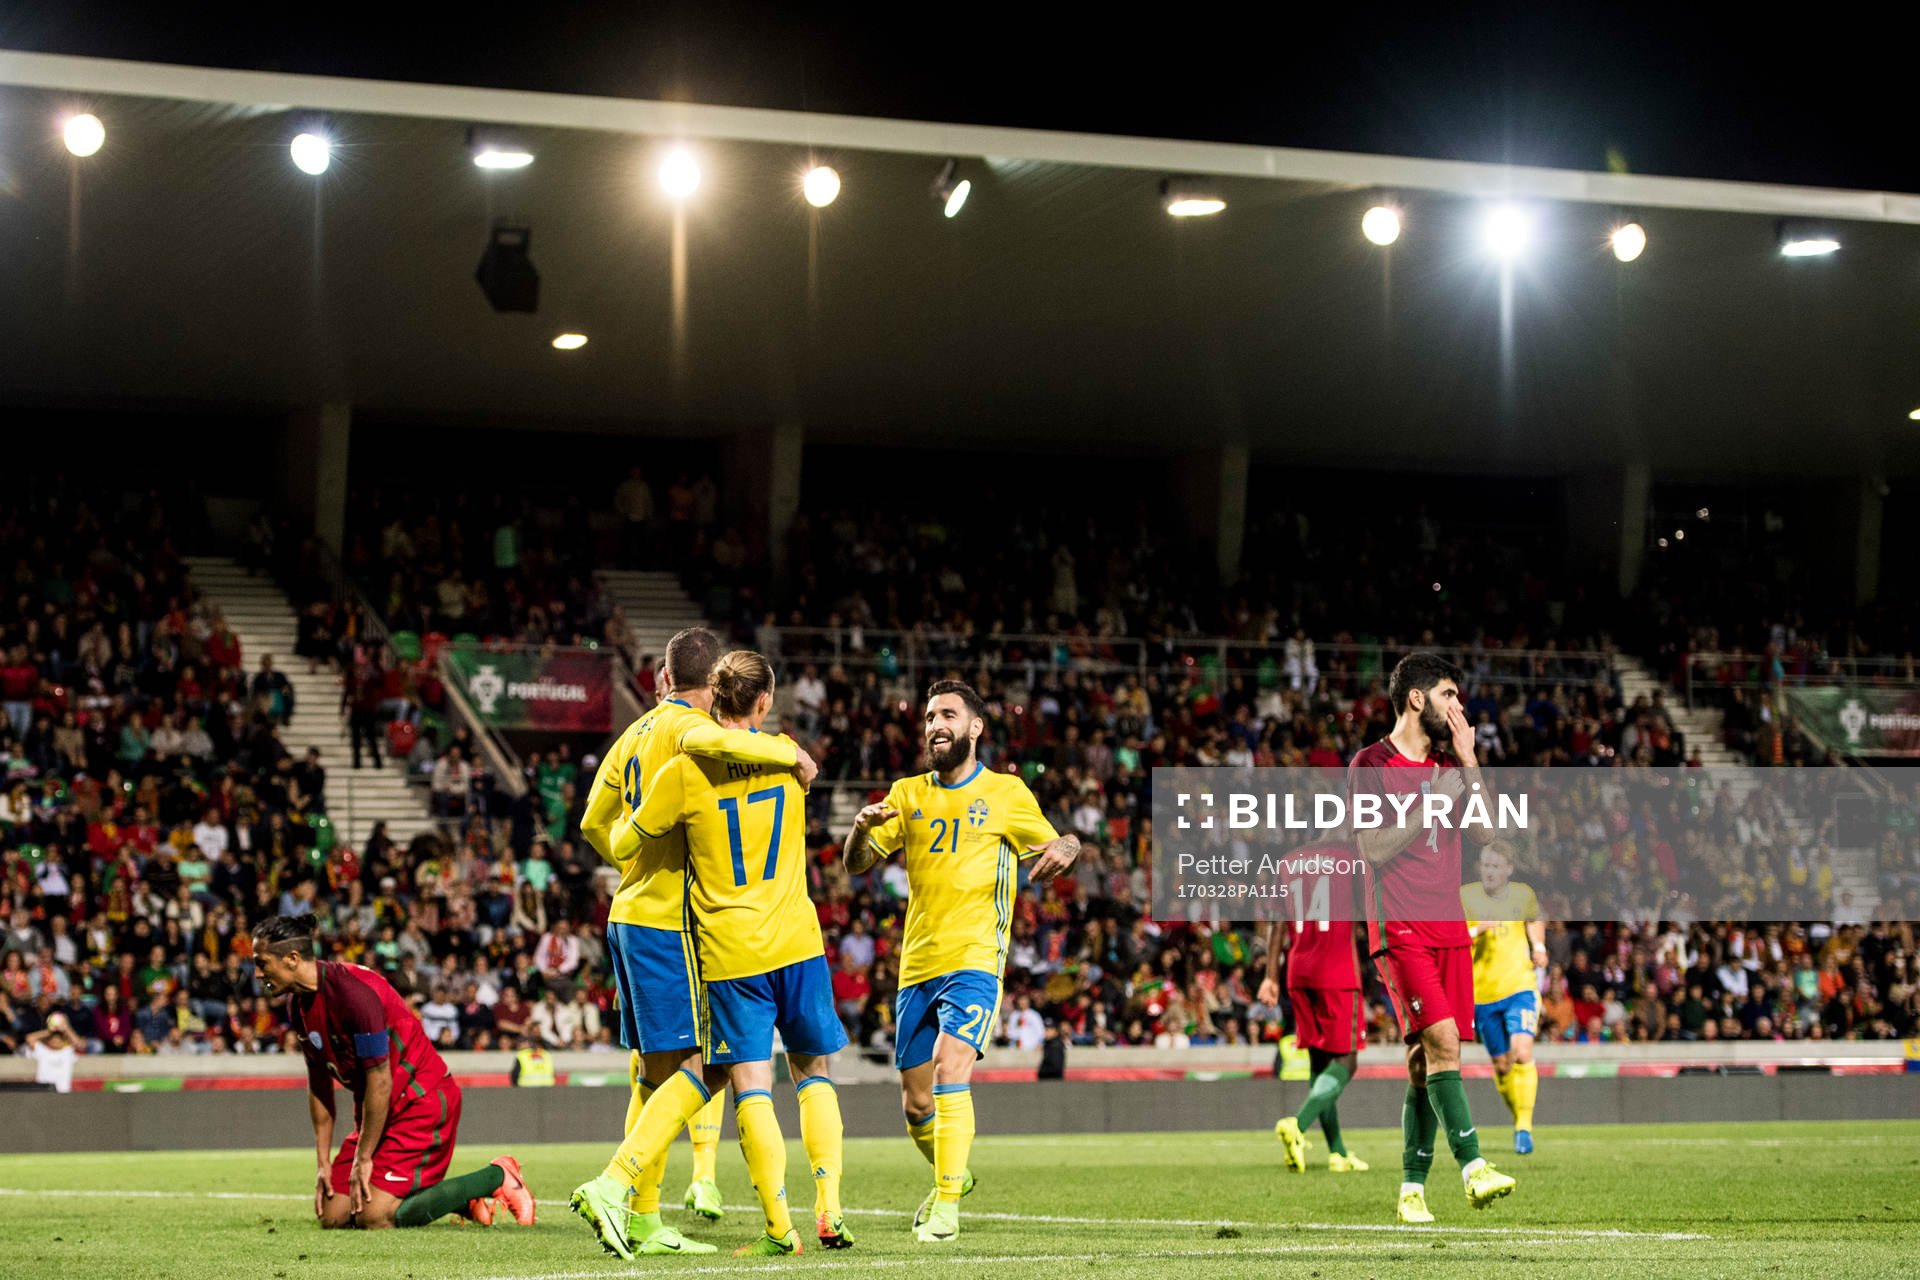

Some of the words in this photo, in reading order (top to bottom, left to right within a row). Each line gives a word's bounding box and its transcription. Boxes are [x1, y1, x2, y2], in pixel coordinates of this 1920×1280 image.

[507, 681, 587, 702] PORTUGAL
[718, 785, 785, 887] 17
[929, 818, 960, 853] 21
[1290, 875, 1330, 934] 14
[957, 1003, 992, 1045] 21
